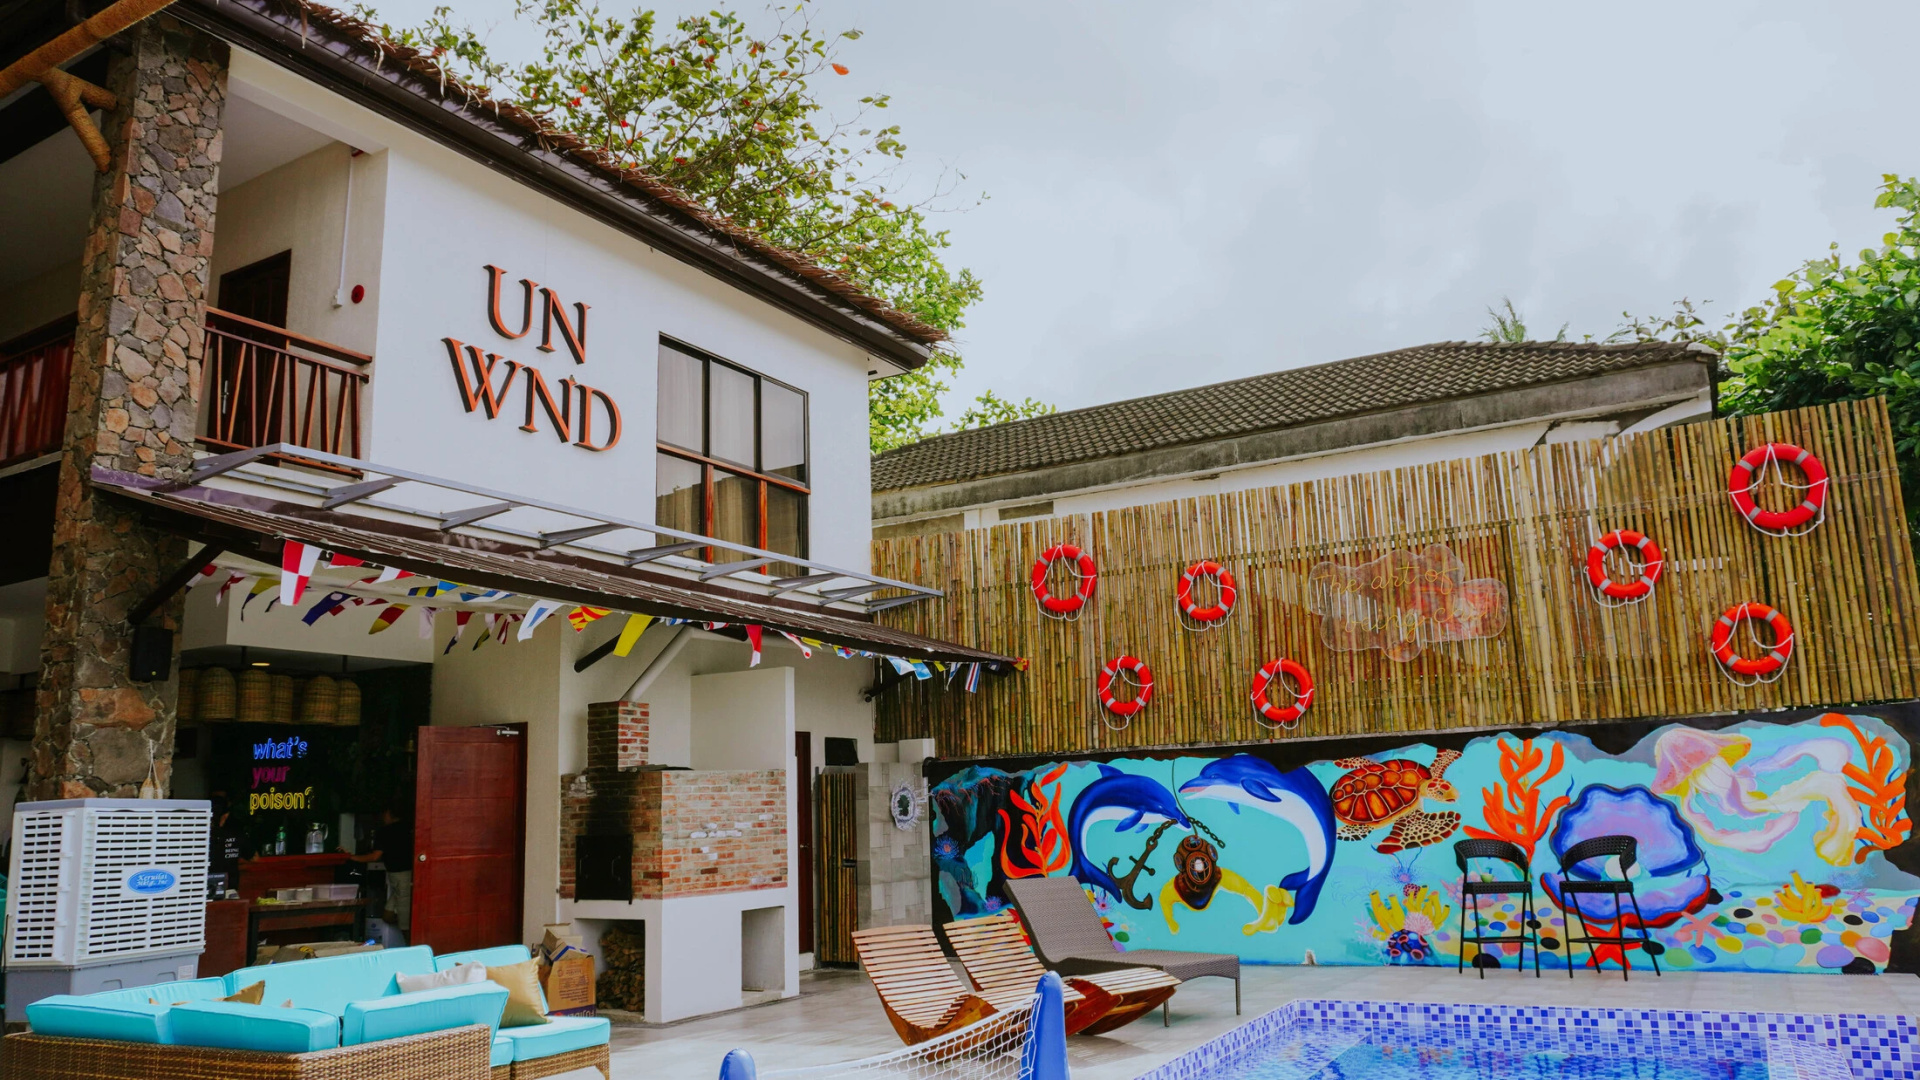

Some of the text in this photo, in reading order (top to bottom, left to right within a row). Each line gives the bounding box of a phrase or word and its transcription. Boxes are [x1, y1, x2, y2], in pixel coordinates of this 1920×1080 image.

[482, 264, 592, 365] UN
[440, 337, 622, 452] WND
[1313, 561, 1459, 602] The art of
[1344, 605, 1425, 643] being
[252, 736, 308, 760] what's
[251, 765, 291, 789] your
[249, 786, 315, 815] poison?
